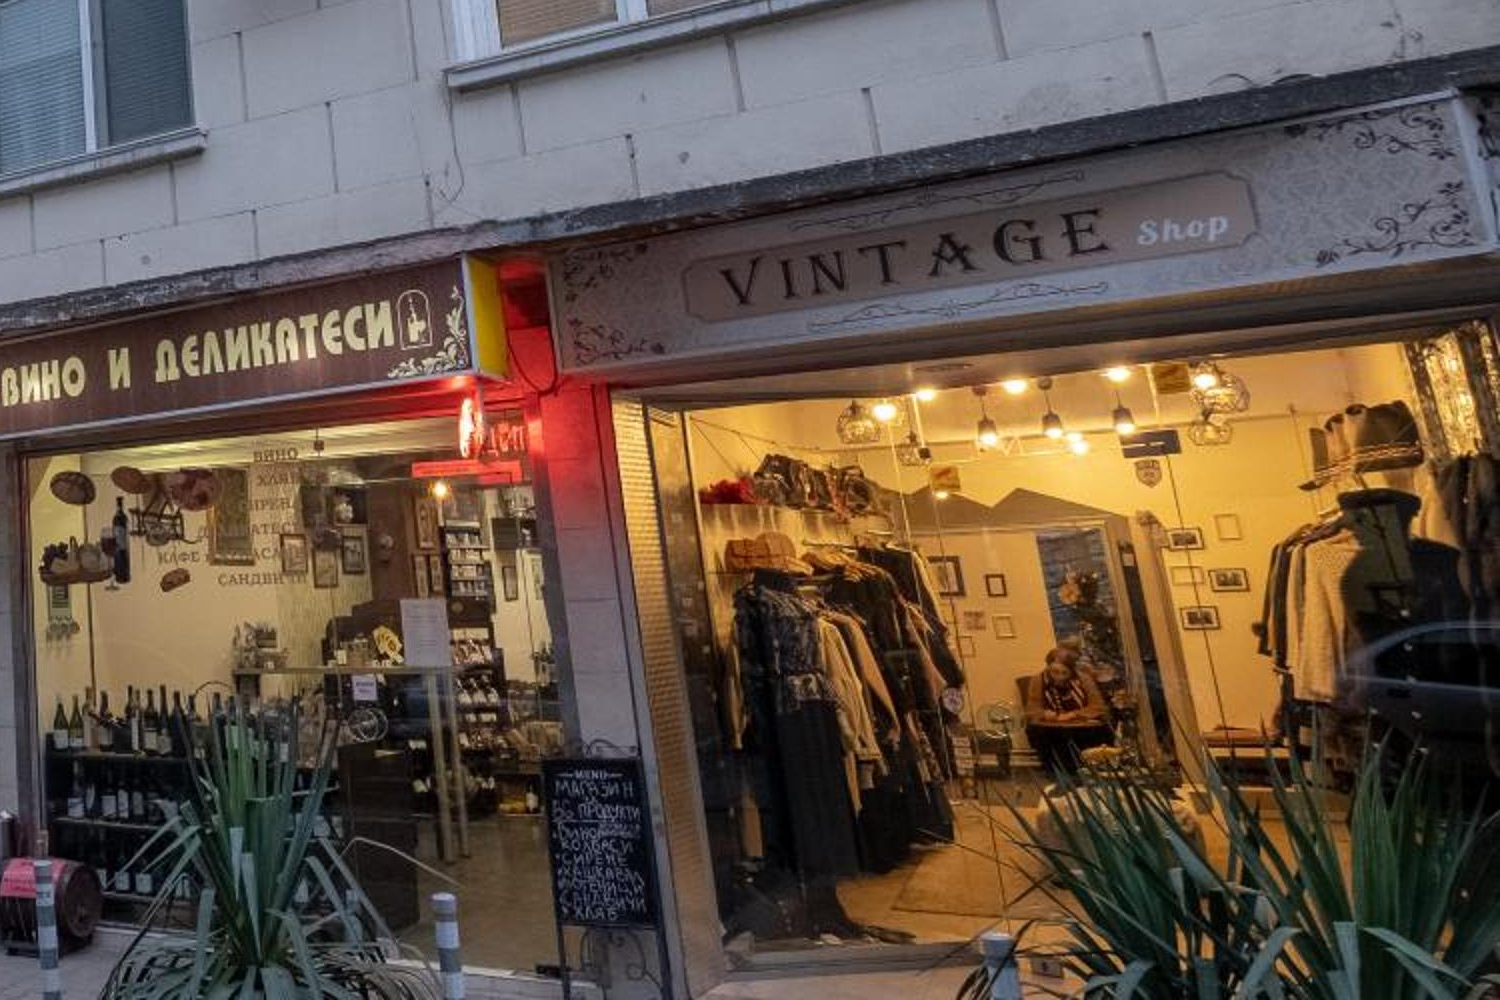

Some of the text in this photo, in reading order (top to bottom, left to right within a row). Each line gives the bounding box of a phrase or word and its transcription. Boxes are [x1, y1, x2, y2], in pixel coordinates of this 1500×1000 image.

[719, 208, 1230, 306] VINTAGE Shop
[1, 300, 395, 407] ВИНО И ДЕЛИКАТЕСИ
